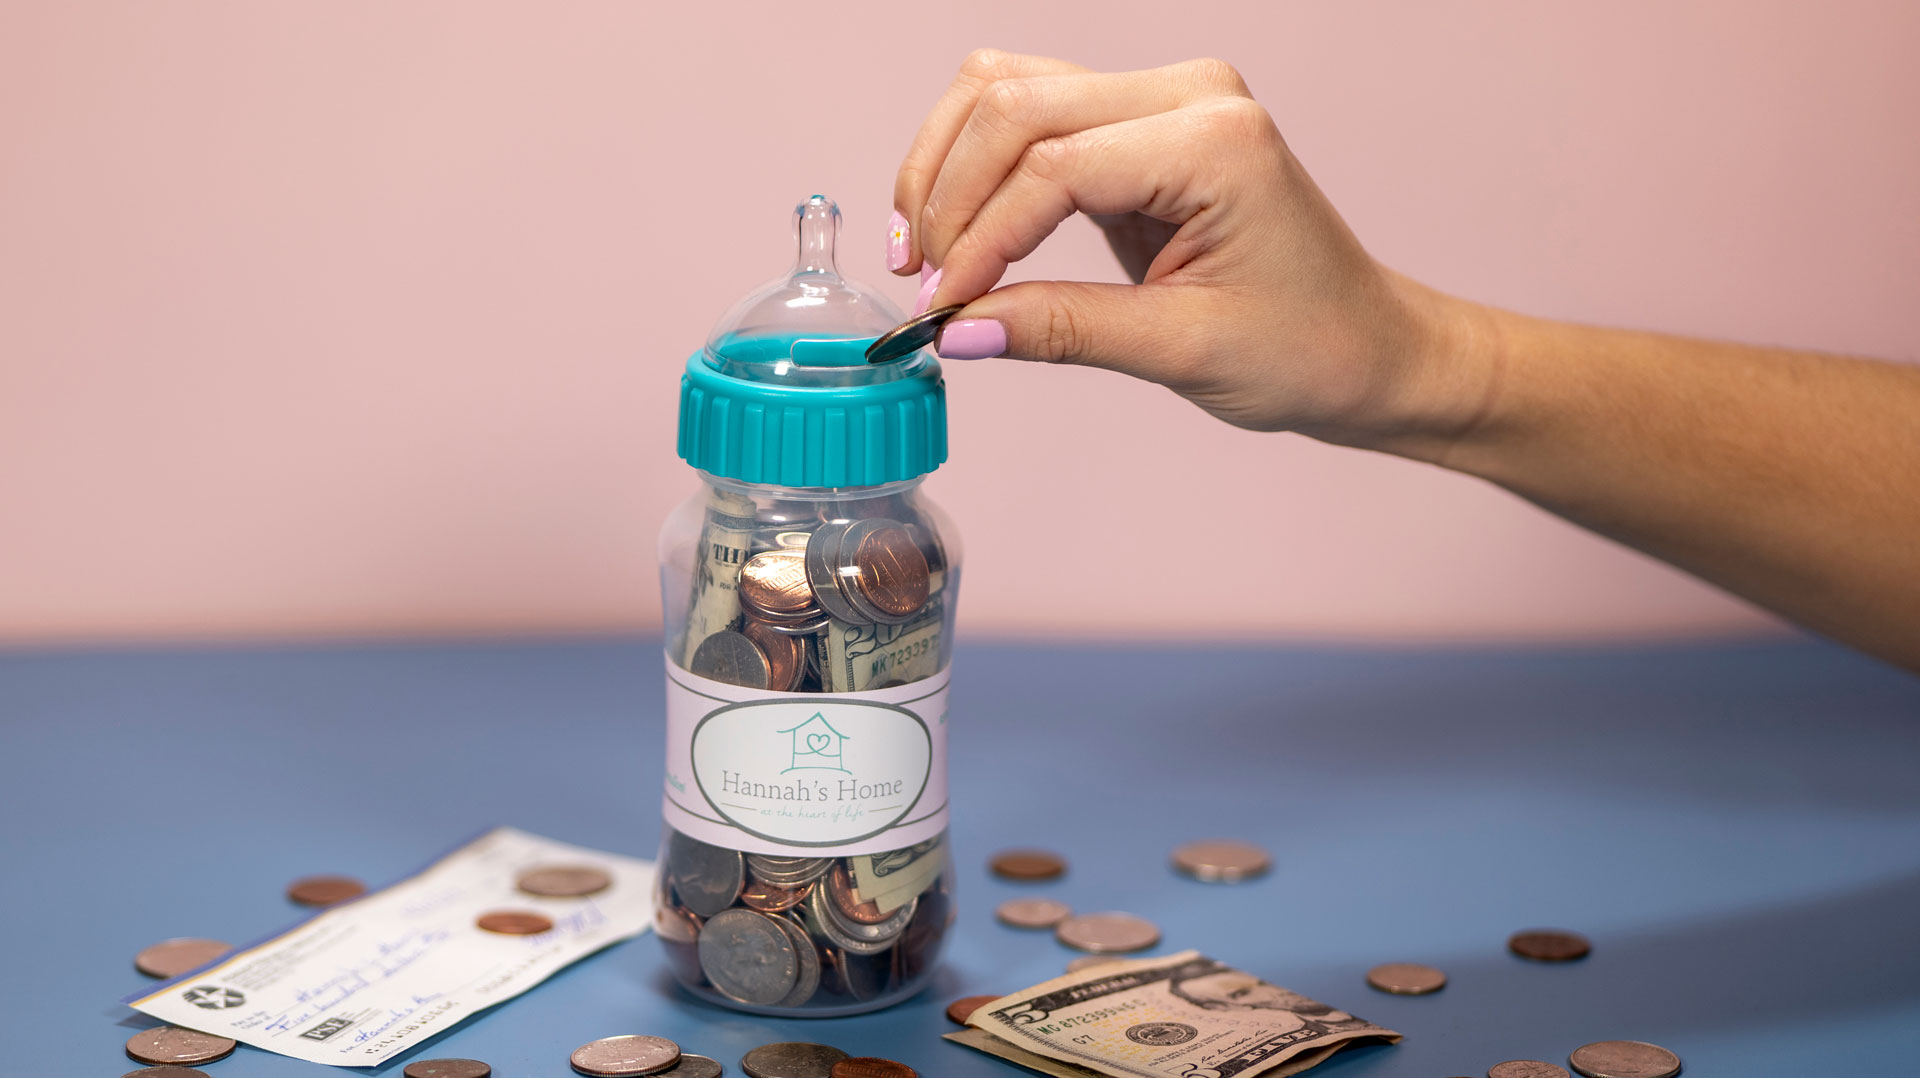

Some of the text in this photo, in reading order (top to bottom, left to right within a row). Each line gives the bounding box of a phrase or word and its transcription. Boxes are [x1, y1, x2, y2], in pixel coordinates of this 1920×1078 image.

[722, 770, 903, 801] Hannah's Home
[760, 803, 865, 823] at the heart of life
